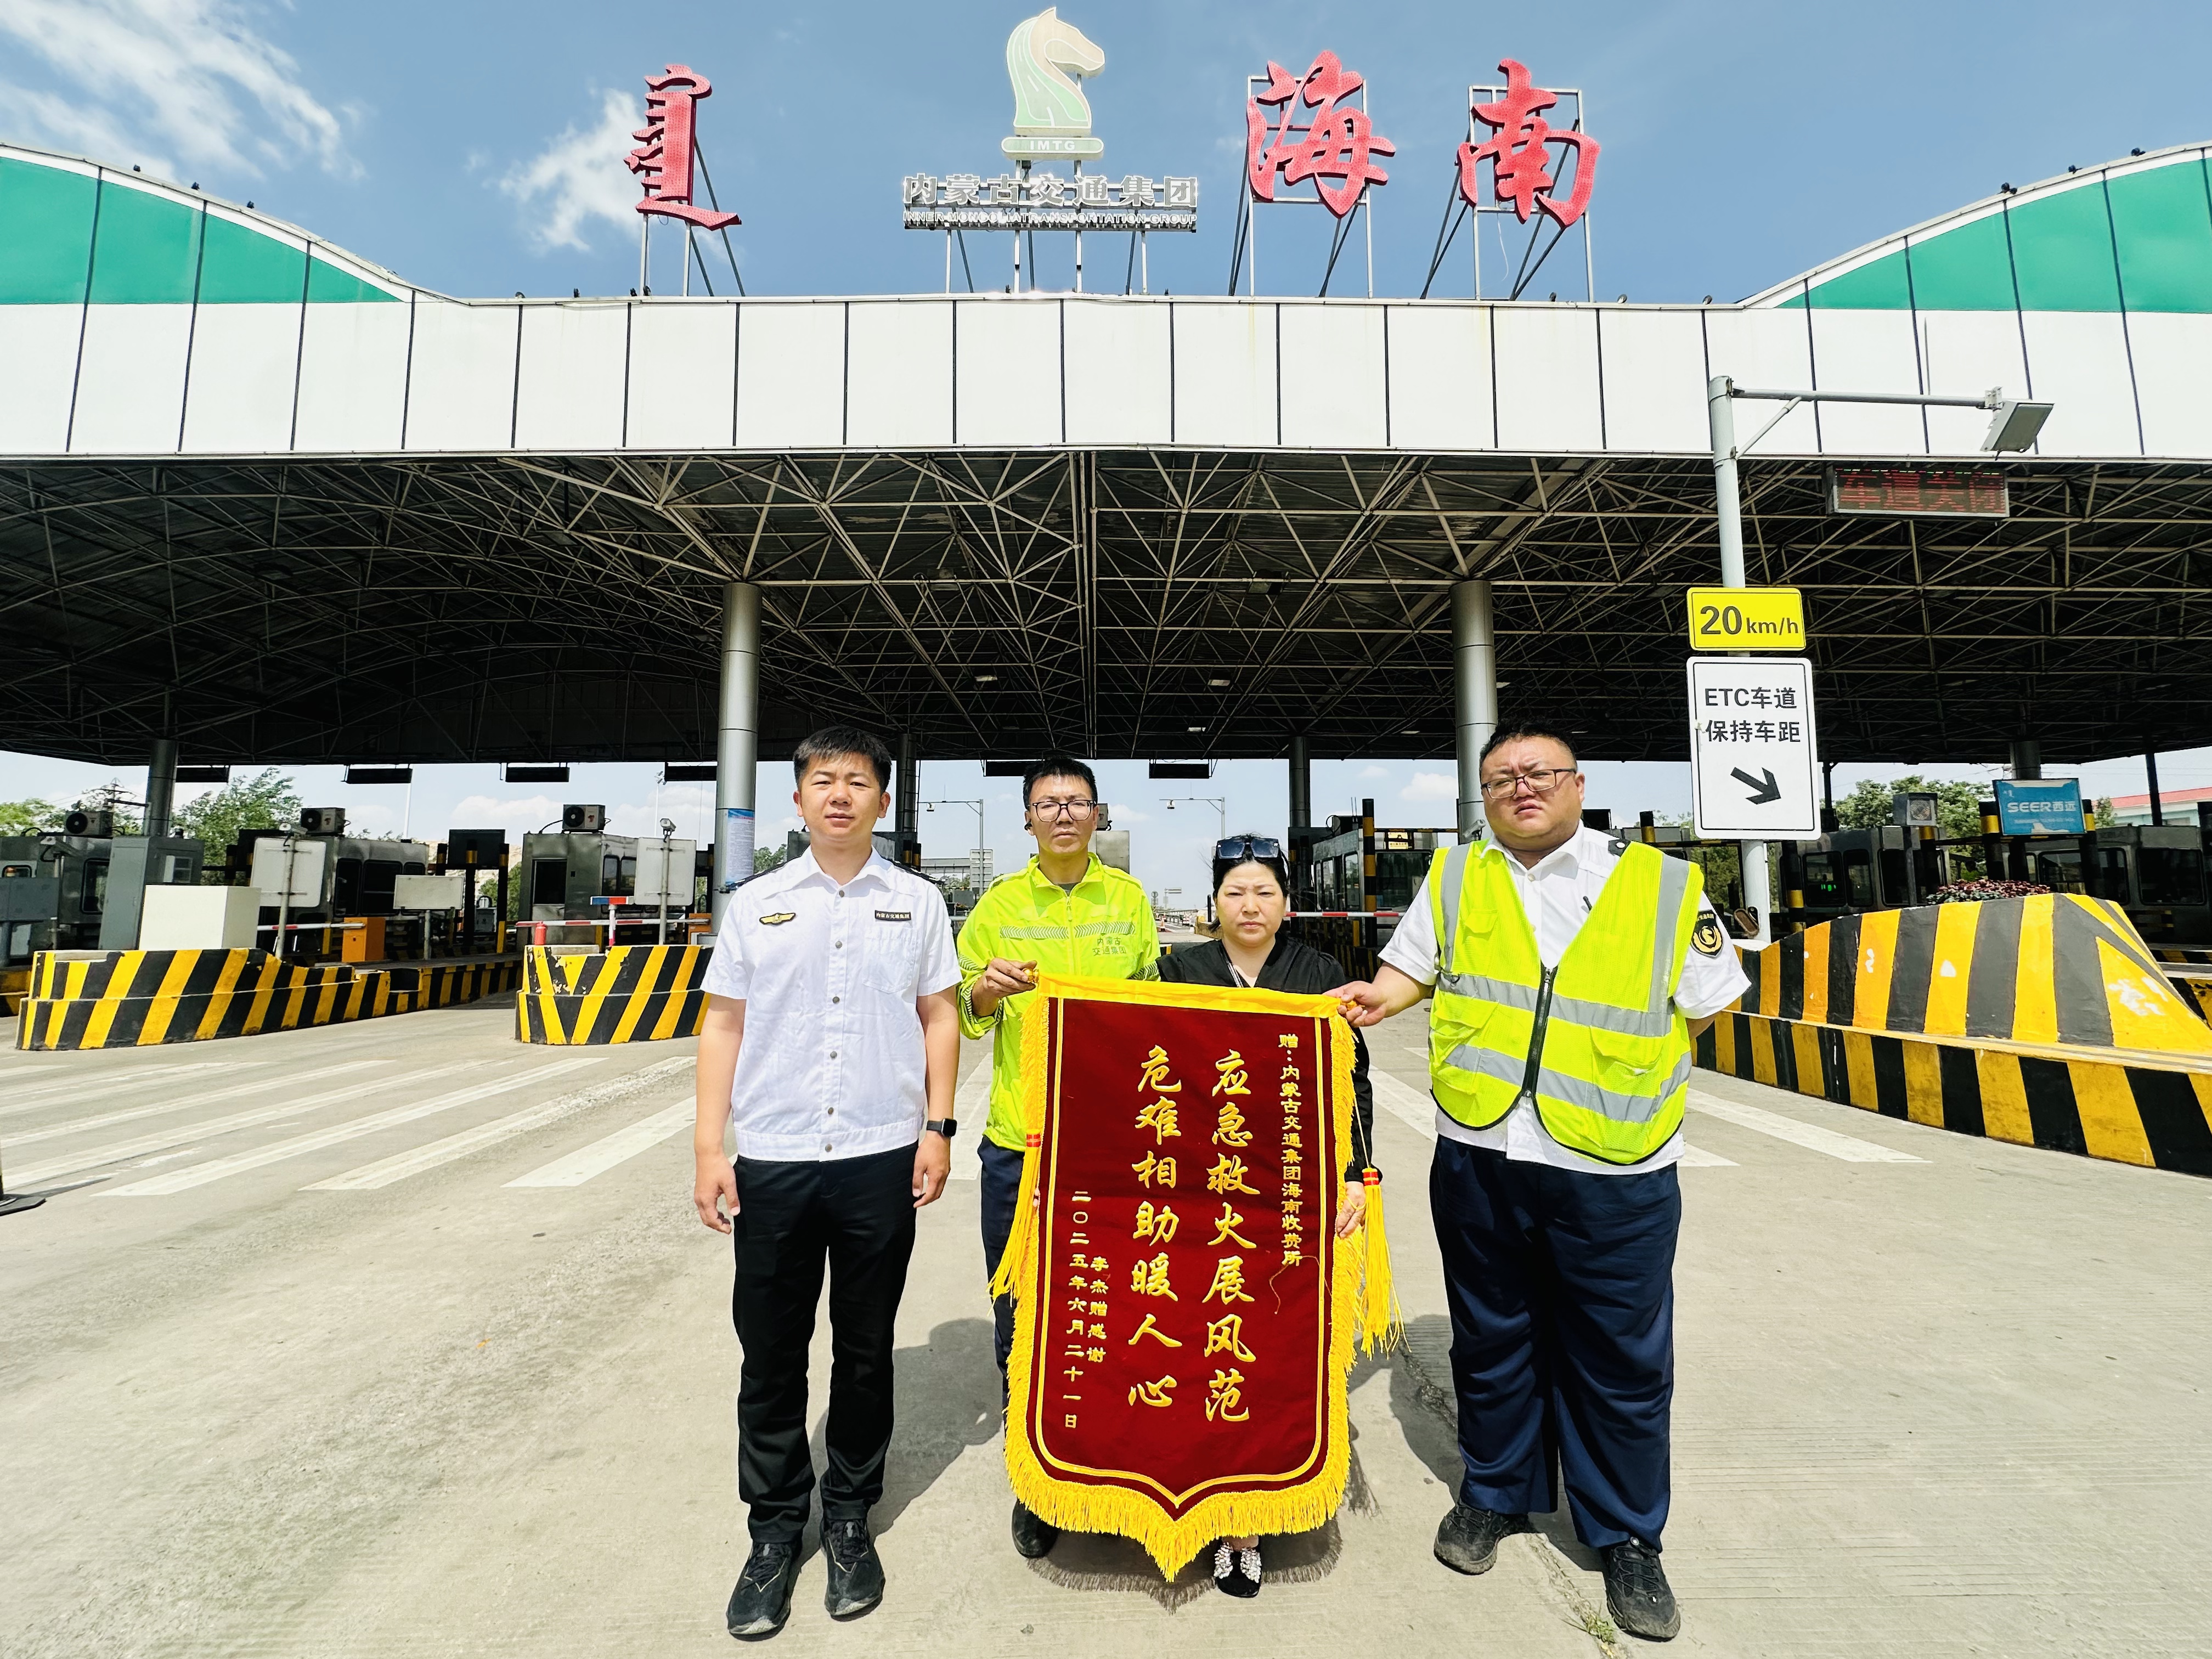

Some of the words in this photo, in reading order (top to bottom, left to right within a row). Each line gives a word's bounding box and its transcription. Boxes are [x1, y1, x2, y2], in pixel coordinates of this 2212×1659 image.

[1029, 140, 1076, 151] IMTG
[1247, 50, 1601, 228] 海南
[904, 173, 1198, 207] 内蒙古交通集团
[903, 211, 945, 222] INNER
[1150, 213, 1198, 225] GROUP
[1705, 686, 1797, 709] ETC车道
[1705, 720, 1801, 743] 保持车距
[1092, 946, 1126, 956] 交通集团
[1097, 936, 1121, 946] 内蒙古
[1127, 1044, 1183, 1407] 危难相助暖人心
[1202, 1048, 1260, 1422] 应急救火展风范
[1086, 1256, 1109, 1363] 李杰赠感谢
